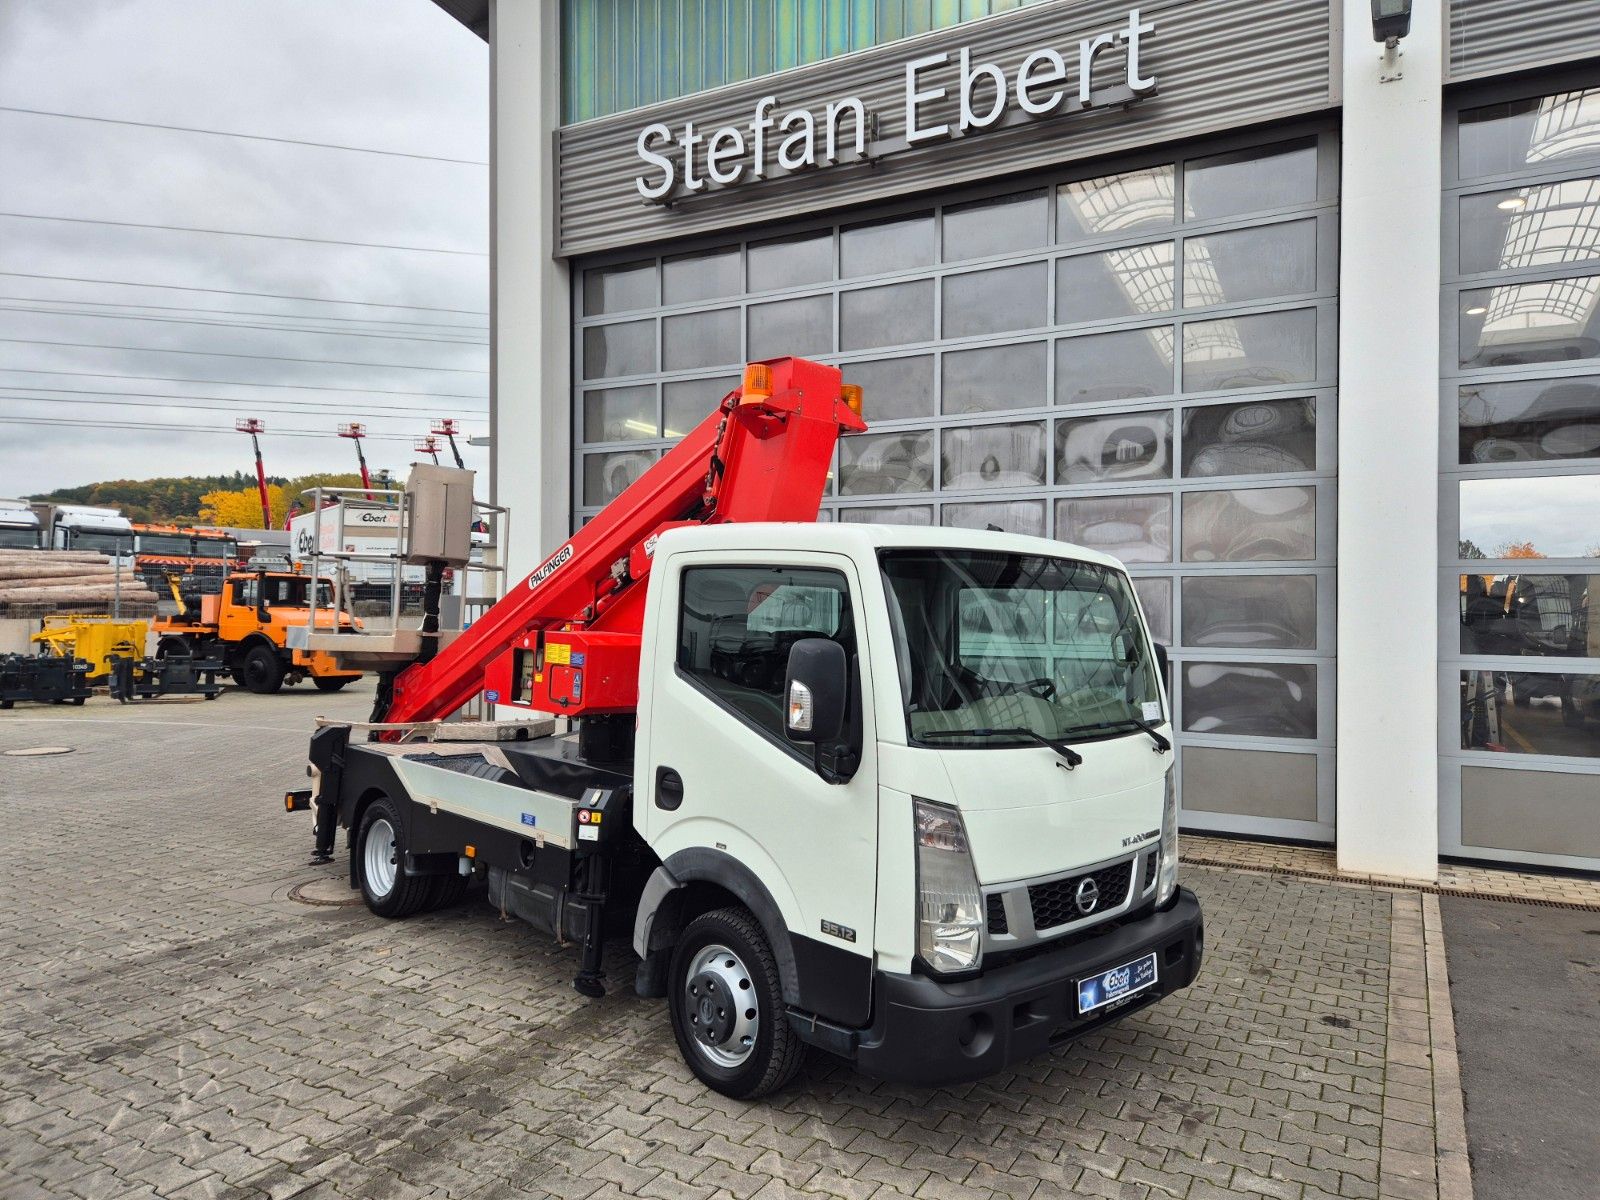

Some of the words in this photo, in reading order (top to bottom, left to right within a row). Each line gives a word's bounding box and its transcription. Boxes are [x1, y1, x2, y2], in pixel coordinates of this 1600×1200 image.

[636, 95, 868, 199] Stefan
[905, 8, 1157, 145] Ebert
[362, 513, 387, 523] Ebert
[530, 546, 571, 587] PALFINGER
[822, 921, 854, 941] 35.12
[1109, 971, 1130, 989] Ebert
